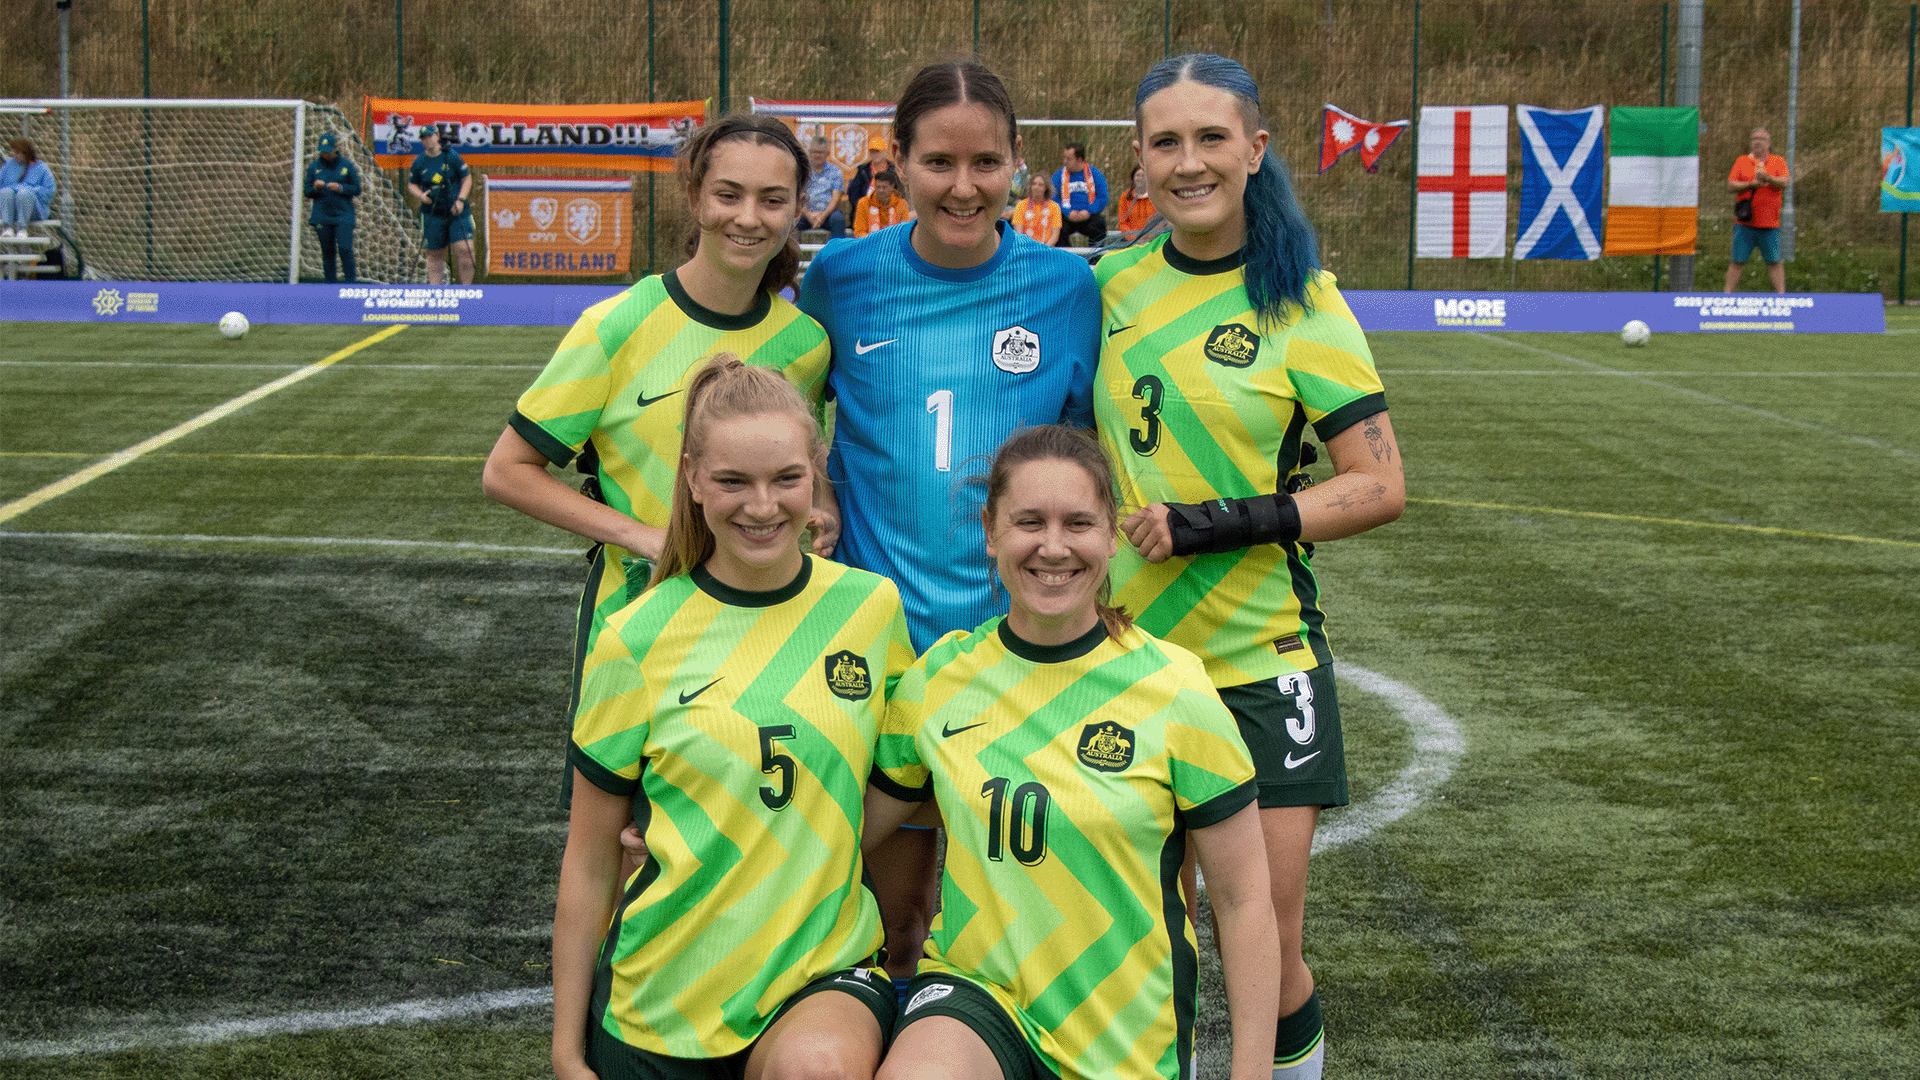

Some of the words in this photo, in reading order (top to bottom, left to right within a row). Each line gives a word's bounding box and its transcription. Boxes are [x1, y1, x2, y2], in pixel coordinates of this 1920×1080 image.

[503, 252, 617, 270] NEDERLAND
[339, 288, 368, 298] 2025
[404, 289, 443, 299] MEN'S
[444, 289, 483, 299] EUROS
[376, 298, 436, 308] WOMEN'S
[1434, 299, 1506, 317] MORE
[1212, 346, 1246, 359] AUSTRALIA
[1130, 375, 1165, 457] 3
[927, 389, 954, 471] 1
[1277, 671, 1316, 745] 3
[1086, 750, 1123, 761] AUSTRALIA
[758, 724, 798, 812] 5
[981, 777, 1050, 867] 10
